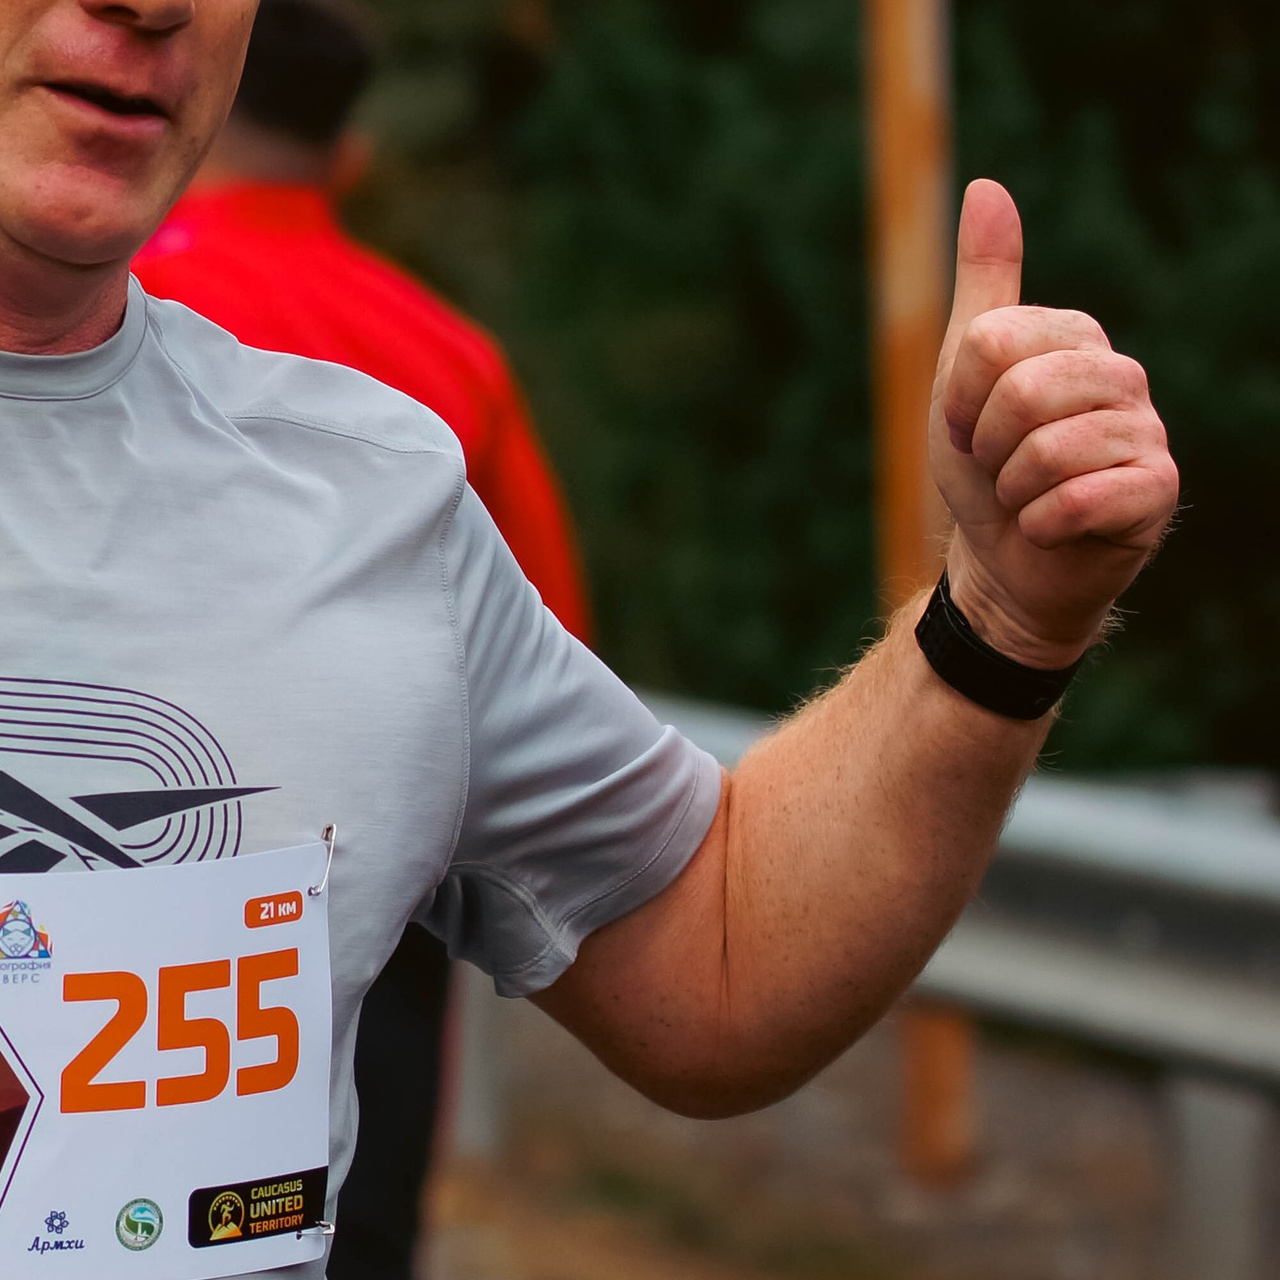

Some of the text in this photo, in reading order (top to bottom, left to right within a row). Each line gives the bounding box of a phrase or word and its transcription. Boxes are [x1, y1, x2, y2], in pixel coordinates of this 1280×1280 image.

[260, 901, 275, 920] 21
[60, 947, 299, 1114] 255
[251, 1179, 303, 1200] CAUCASUS
[249, 1194, 304, 1219] UNITED
[249, 1213, 304, 1234] TERRITORY
[27, 1236, 85, 1255] Армхи
